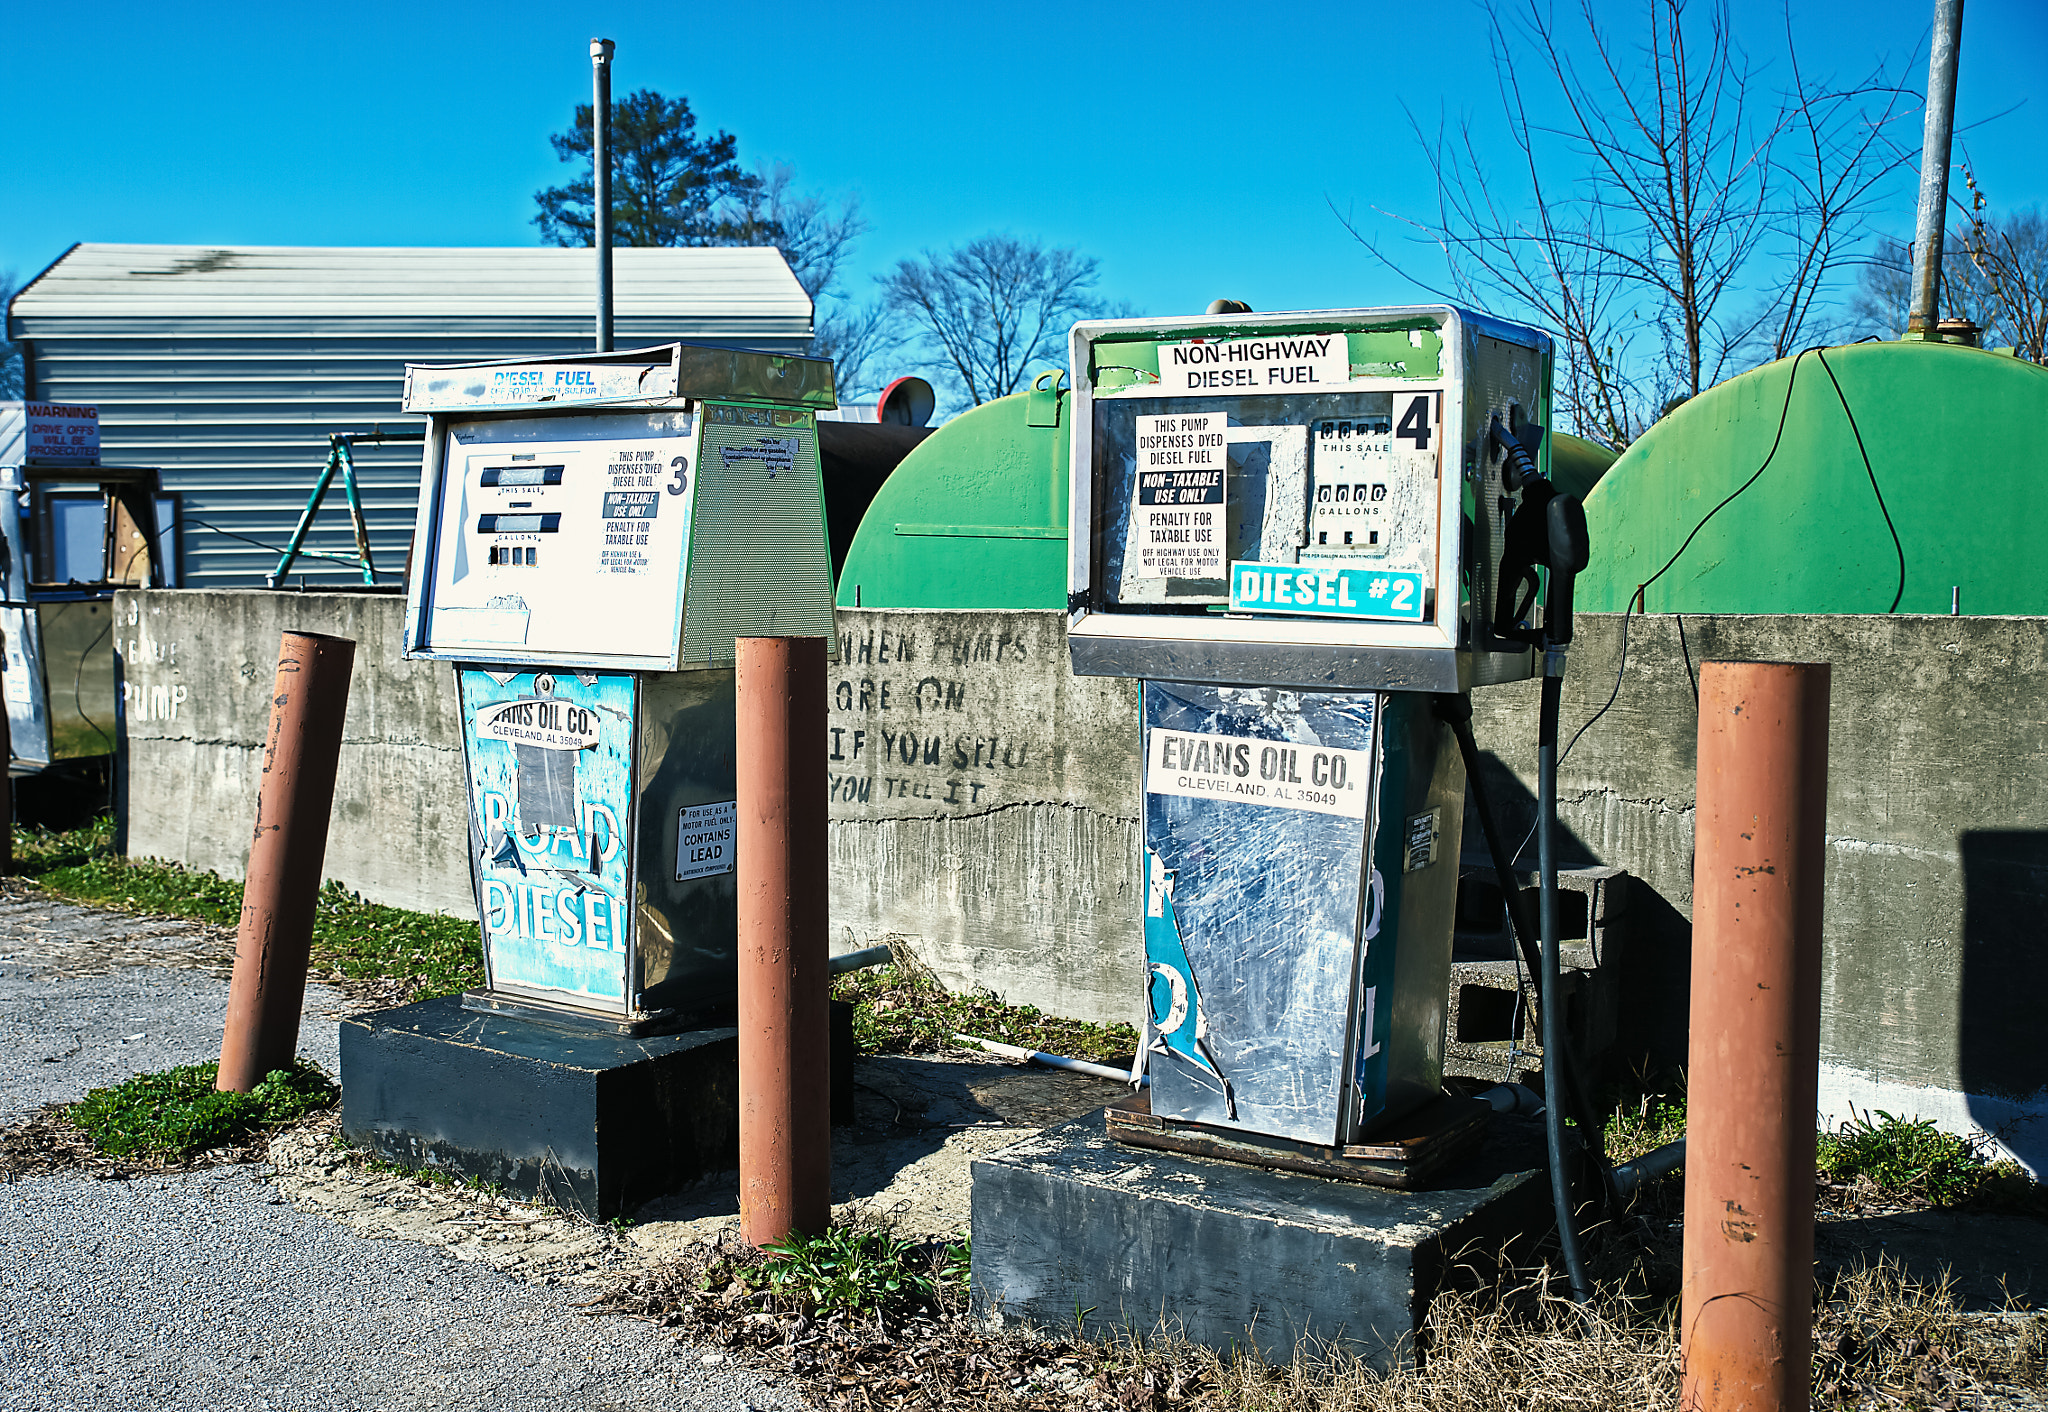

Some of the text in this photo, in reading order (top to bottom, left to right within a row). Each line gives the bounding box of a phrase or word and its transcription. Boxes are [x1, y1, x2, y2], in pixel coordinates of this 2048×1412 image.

[1173, 338, 1331, 365] NON-HIGHWAY
[494, 371, 595, 386] DIESEL FUEL
[1187, 366, 1320, 388] DIESEL FUEL
[27, 405, 97, 419] WARNING
[32, 424, 95, 436] DRIVE OFFS
[1155, 418, 1209, 433] THIS PUMP
[1396, 396, 1432, 450] 4
[43, 435, 86, 446] WILL BE
[1140, 434, 1223, 449] DISPENSES DYED
[29, 445, 100, 457] PROSECUTED
[1323, 444, 1389, 452] THIS SALE
[619, 450, 654, 462] THIS PUMP
[1150, 451, 1212, 465] DIESEL FUEL
[608, 463, 662, 475] DISPENSES DYED
[667, 456, 688, 496] 3
[612, 476, 653, 487] DIESEL FUEL
[1143, 472, 1220, 488] NON-TAXABLE
[607, 493, 656, 505] NON-TAXABLE
[1154, 488, 1208, 504] USE ONLY
[613, 505, 648, 517] USE ONLY
[1319, 507, 1380, 515] GALLONS
[1150, 512, 1212, 526] PENALTY FOR
[606, 521, 650, 532] PENALTY FOR
[605, 534, 649, 545] TAXABLE USE
[1150, 529, 1212, 543] TAXABLE USE
[1142, 548, 1220, 557] OFF HIGHWAY USE ONLY
[1143, 558, 1219, 566] NOT LEGAL FOR MOTOR
[1159, 567, 1202, 576] VEHICLE USE
[1239, 571, 1414, 611] DIESEL #2
[123, 681, 188, 721] PUMP
[915, 676, 965, 713] ON
[494, 702, 593, 736] ANS OIL CO.
[546, 733, 557, 744] AL
[559, 735, 583, 747] 35049
[829, 727, 866, 761] IF
[881, 729, 940, 766] YOU
[1162, 735, 1354, 791] EVANS OIL CO.
[829, 772, 986, 805] YOU TELL IT
[1274, 787, 1293, 800] AL
[1297, 789, 1336, 806] 35049
[688, 810, 700, 818] FOR
[702, 808, 713, 817] USE
[715, 806, 722, 815] AS
[683, 820, 702, 830] MOTOR
[704, 818, 717, 827] FUEL
[684, 828, 730, 846] CONTAINS
[690, 845, 723, 863] LEAD
[483, 880, 628, 954] DIESEL
